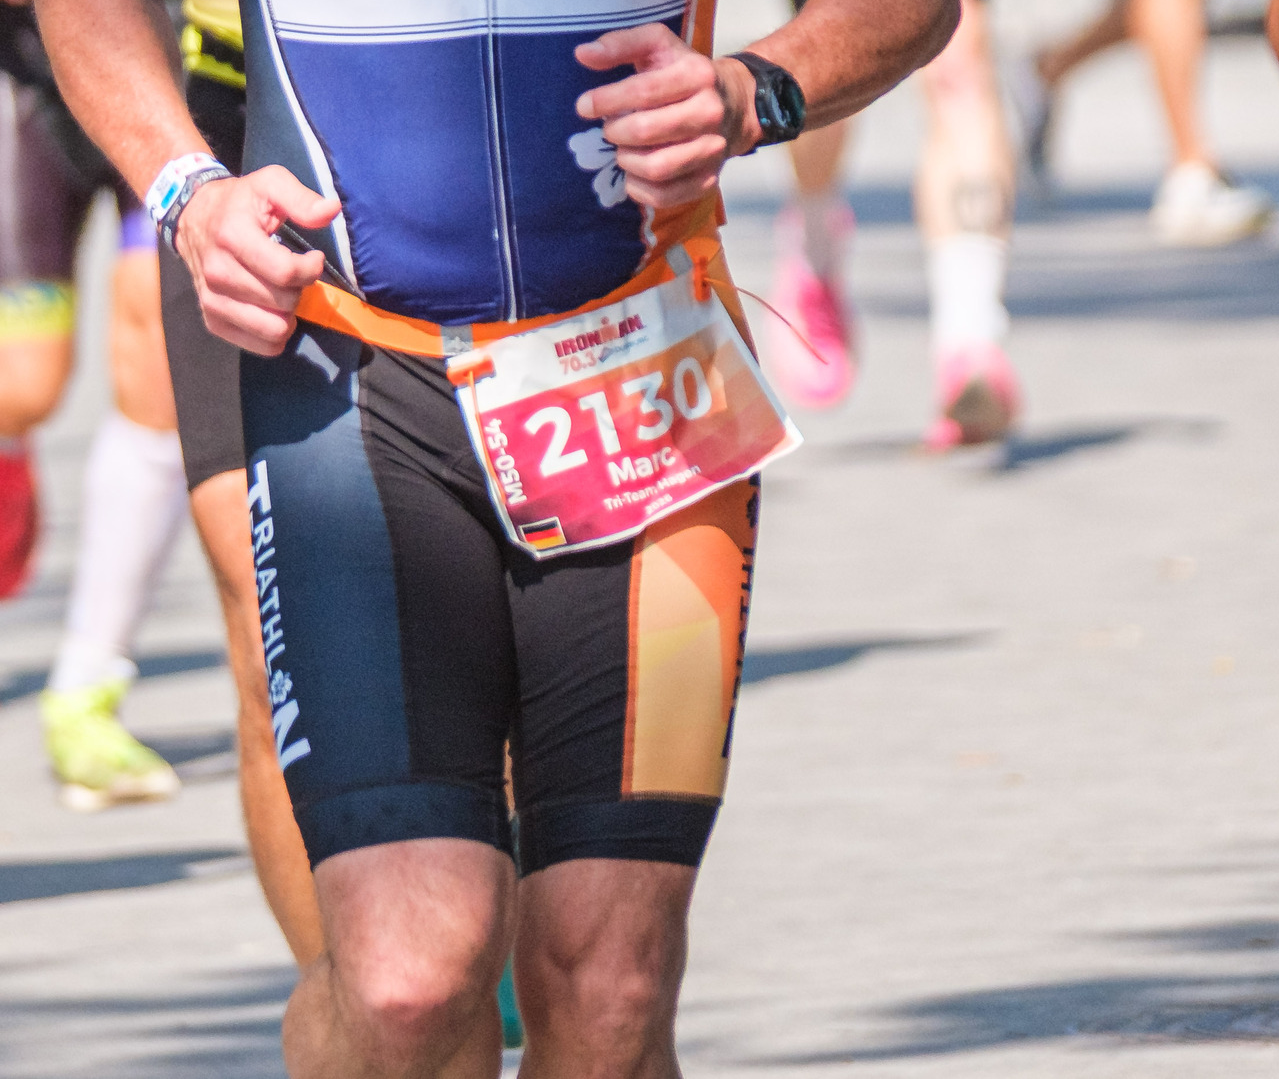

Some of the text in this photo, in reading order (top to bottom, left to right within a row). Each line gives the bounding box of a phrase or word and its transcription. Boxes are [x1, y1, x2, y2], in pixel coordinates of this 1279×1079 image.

[554, 314, 645, 357] IRONMAN
[559, 350, 598, 375] 70.3
[524, 357, 712, 477] 2130
[484, 417, 528, 506] M50-54
[607, 446, 677, 487] Marc
